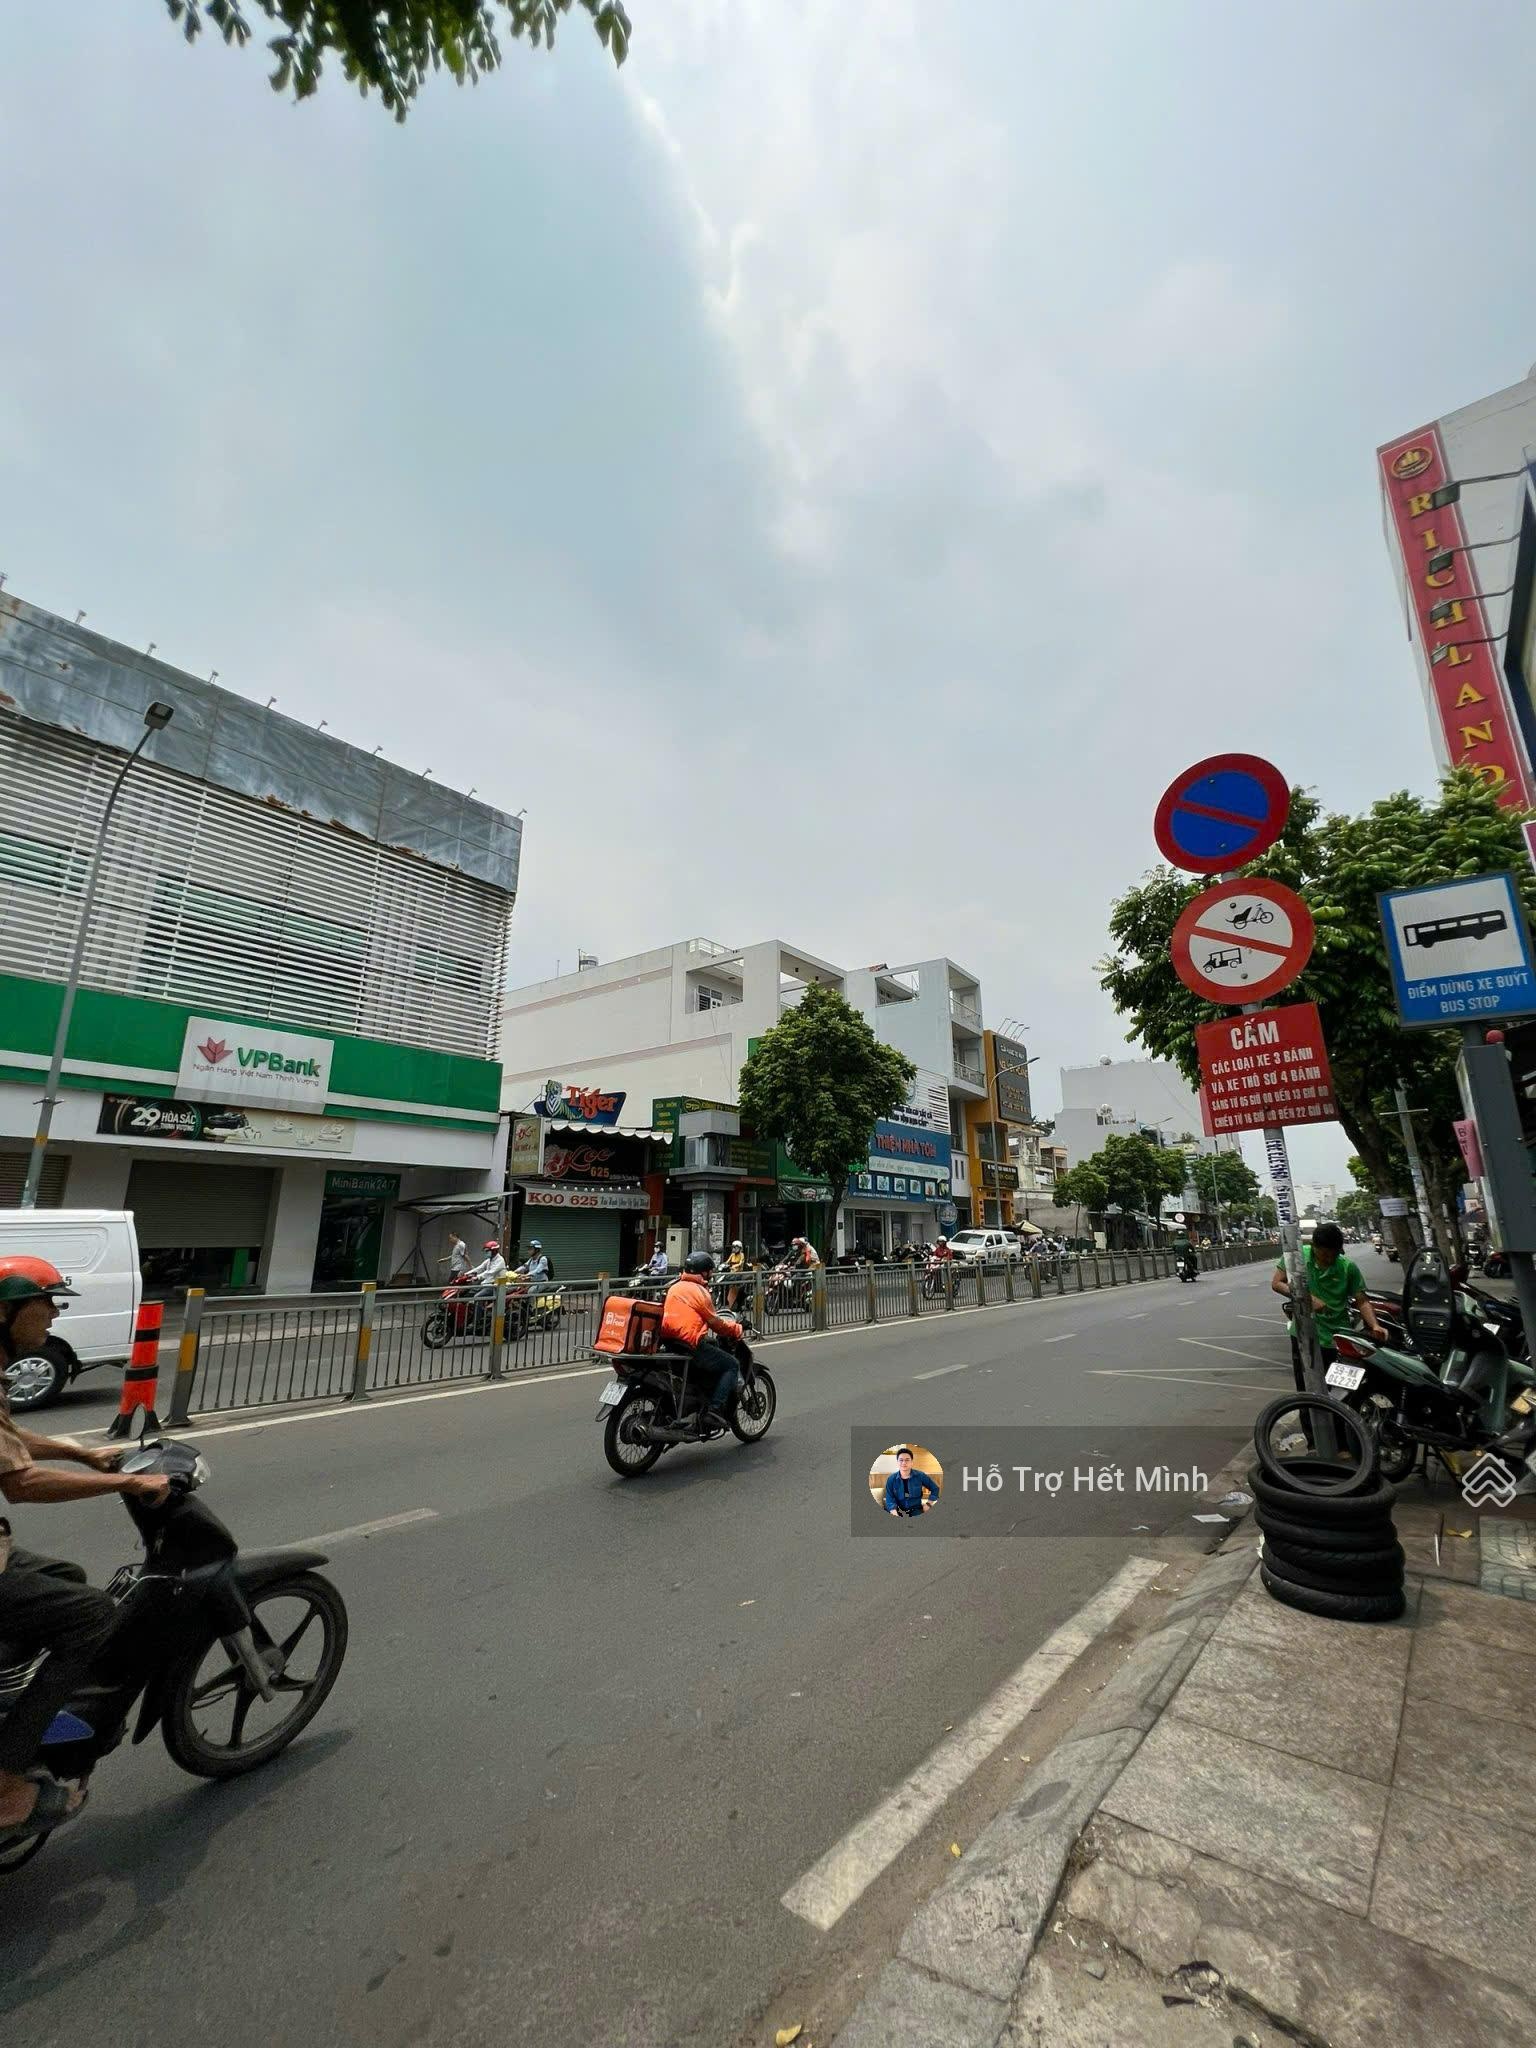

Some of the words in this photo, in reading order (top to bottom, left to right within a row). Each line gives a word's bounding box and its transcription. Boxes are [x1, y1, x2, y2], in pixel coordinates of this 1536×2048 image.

[1408, 982, 1438, 999] ĐIỂM
[1440, 979, 1474, 995] DỪNG
[1478, 977, 1494, 990] XE
[1496, 971, 1529, 988] BUÝT
[1440, 1000, 1466, 1013] BUS
[1468, 995, 1500, 1010] STOP
[1230, 1018, 1280, 1050] CẤM
[237, 1047, 322, 1078] VPBank
[1211, 1059, 1231, 1075] CÁC
[1232, 1056, 1255, 1072] LOẠI
[1257, 1053, 1271, 1067] XE
[1274, 1053, 1281, 1064] 3
[1283, 1047, 1313, 1063] BÁNH
[1211, 1078, 1225, 1094] VÀ
[1227, 1078, 1240, 1091] XE
[1263, 1070, 1277, 1086] SƠ
[1280, 1071, 1288, 1083] 4
[1290, 1066, 1321, 1082] BÁNH
[131, 1106, 161, 1127] 29
[566, 1086, 618, 1119] Tiger
[161, 1110, 179, 1123] HÒA
[180, 1111, 197, 1125] SẮC
[590, 1167, 610, 1178] 625
[527, 1192, 565, 1204] KOO
[570, 1194, 599, 1206] 625
